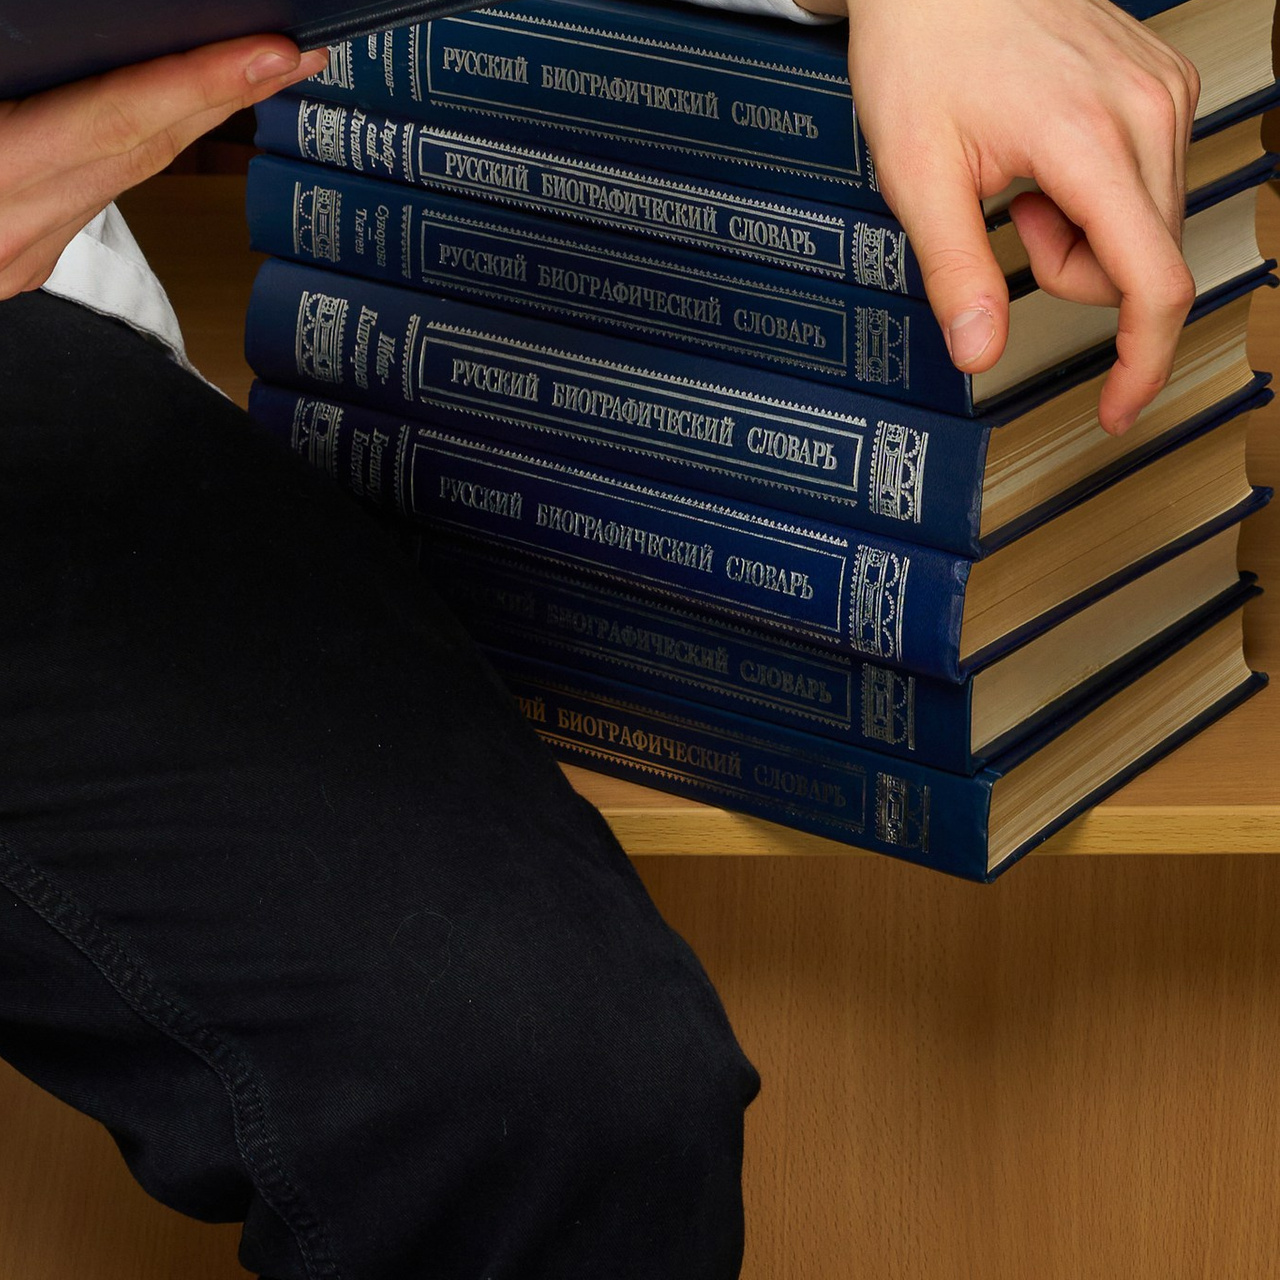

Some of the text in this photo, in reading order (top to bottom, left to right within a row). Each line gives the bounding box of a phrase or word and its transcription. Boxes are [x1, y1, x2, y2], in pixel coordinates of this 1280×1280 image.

[442, 47, 819, 139] РУССКИЙ БИОГРАФИЧЕСКИЙ СЛОВАРЬ
[354, 208, 368, 255] Ткачев
[374, 204, 390, 268] Суворова
[444, 151, 816, 255] РУССКИЙ БИОГРАФИЧЕСКИЙ СЛОВАРЬ
[438, 243, 826, 349] РУССКИЙ БИОГРАФИЧЕСКИЙ СЛОВАРЬ
[450, 357, 839, 471] РУССКИЙ БИОГРАФИЧЕСКИЙ СЛОВАРЬ
[438, 476, 814, 600] РУССКИЙ БИОГРАФИЧЕСКИЙ СЛОВАРЬ
[547, 603, 729, 673] БИОГРАФИЧЕСКИЙ
[739, 659, 832, 705] СЛОВАРЬ
[557, 707, 742, 779] БИОГРАФИЧЕСКИЙ
[753, 764, 847, 809] СЛОВАРЬ
